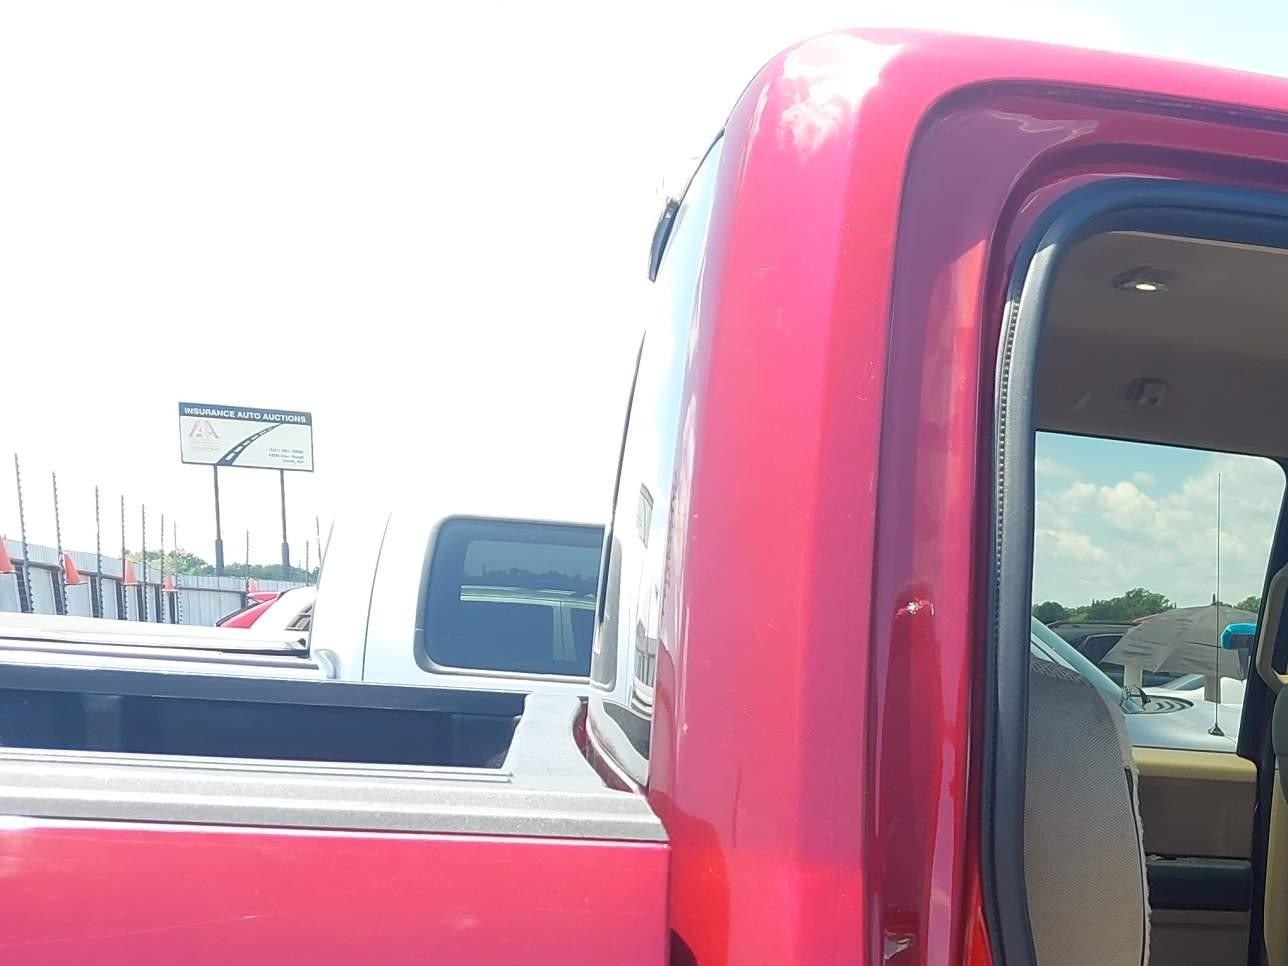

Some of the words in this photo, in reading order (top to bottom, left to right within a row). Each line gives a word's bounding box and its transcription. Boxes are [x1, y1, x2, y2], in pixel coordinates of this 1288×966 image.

[184, 407, 235, 418] INSURANCE
[237, 410, 261, 420] AUTO
[262, 413, 306, 423] AUCTIONS
